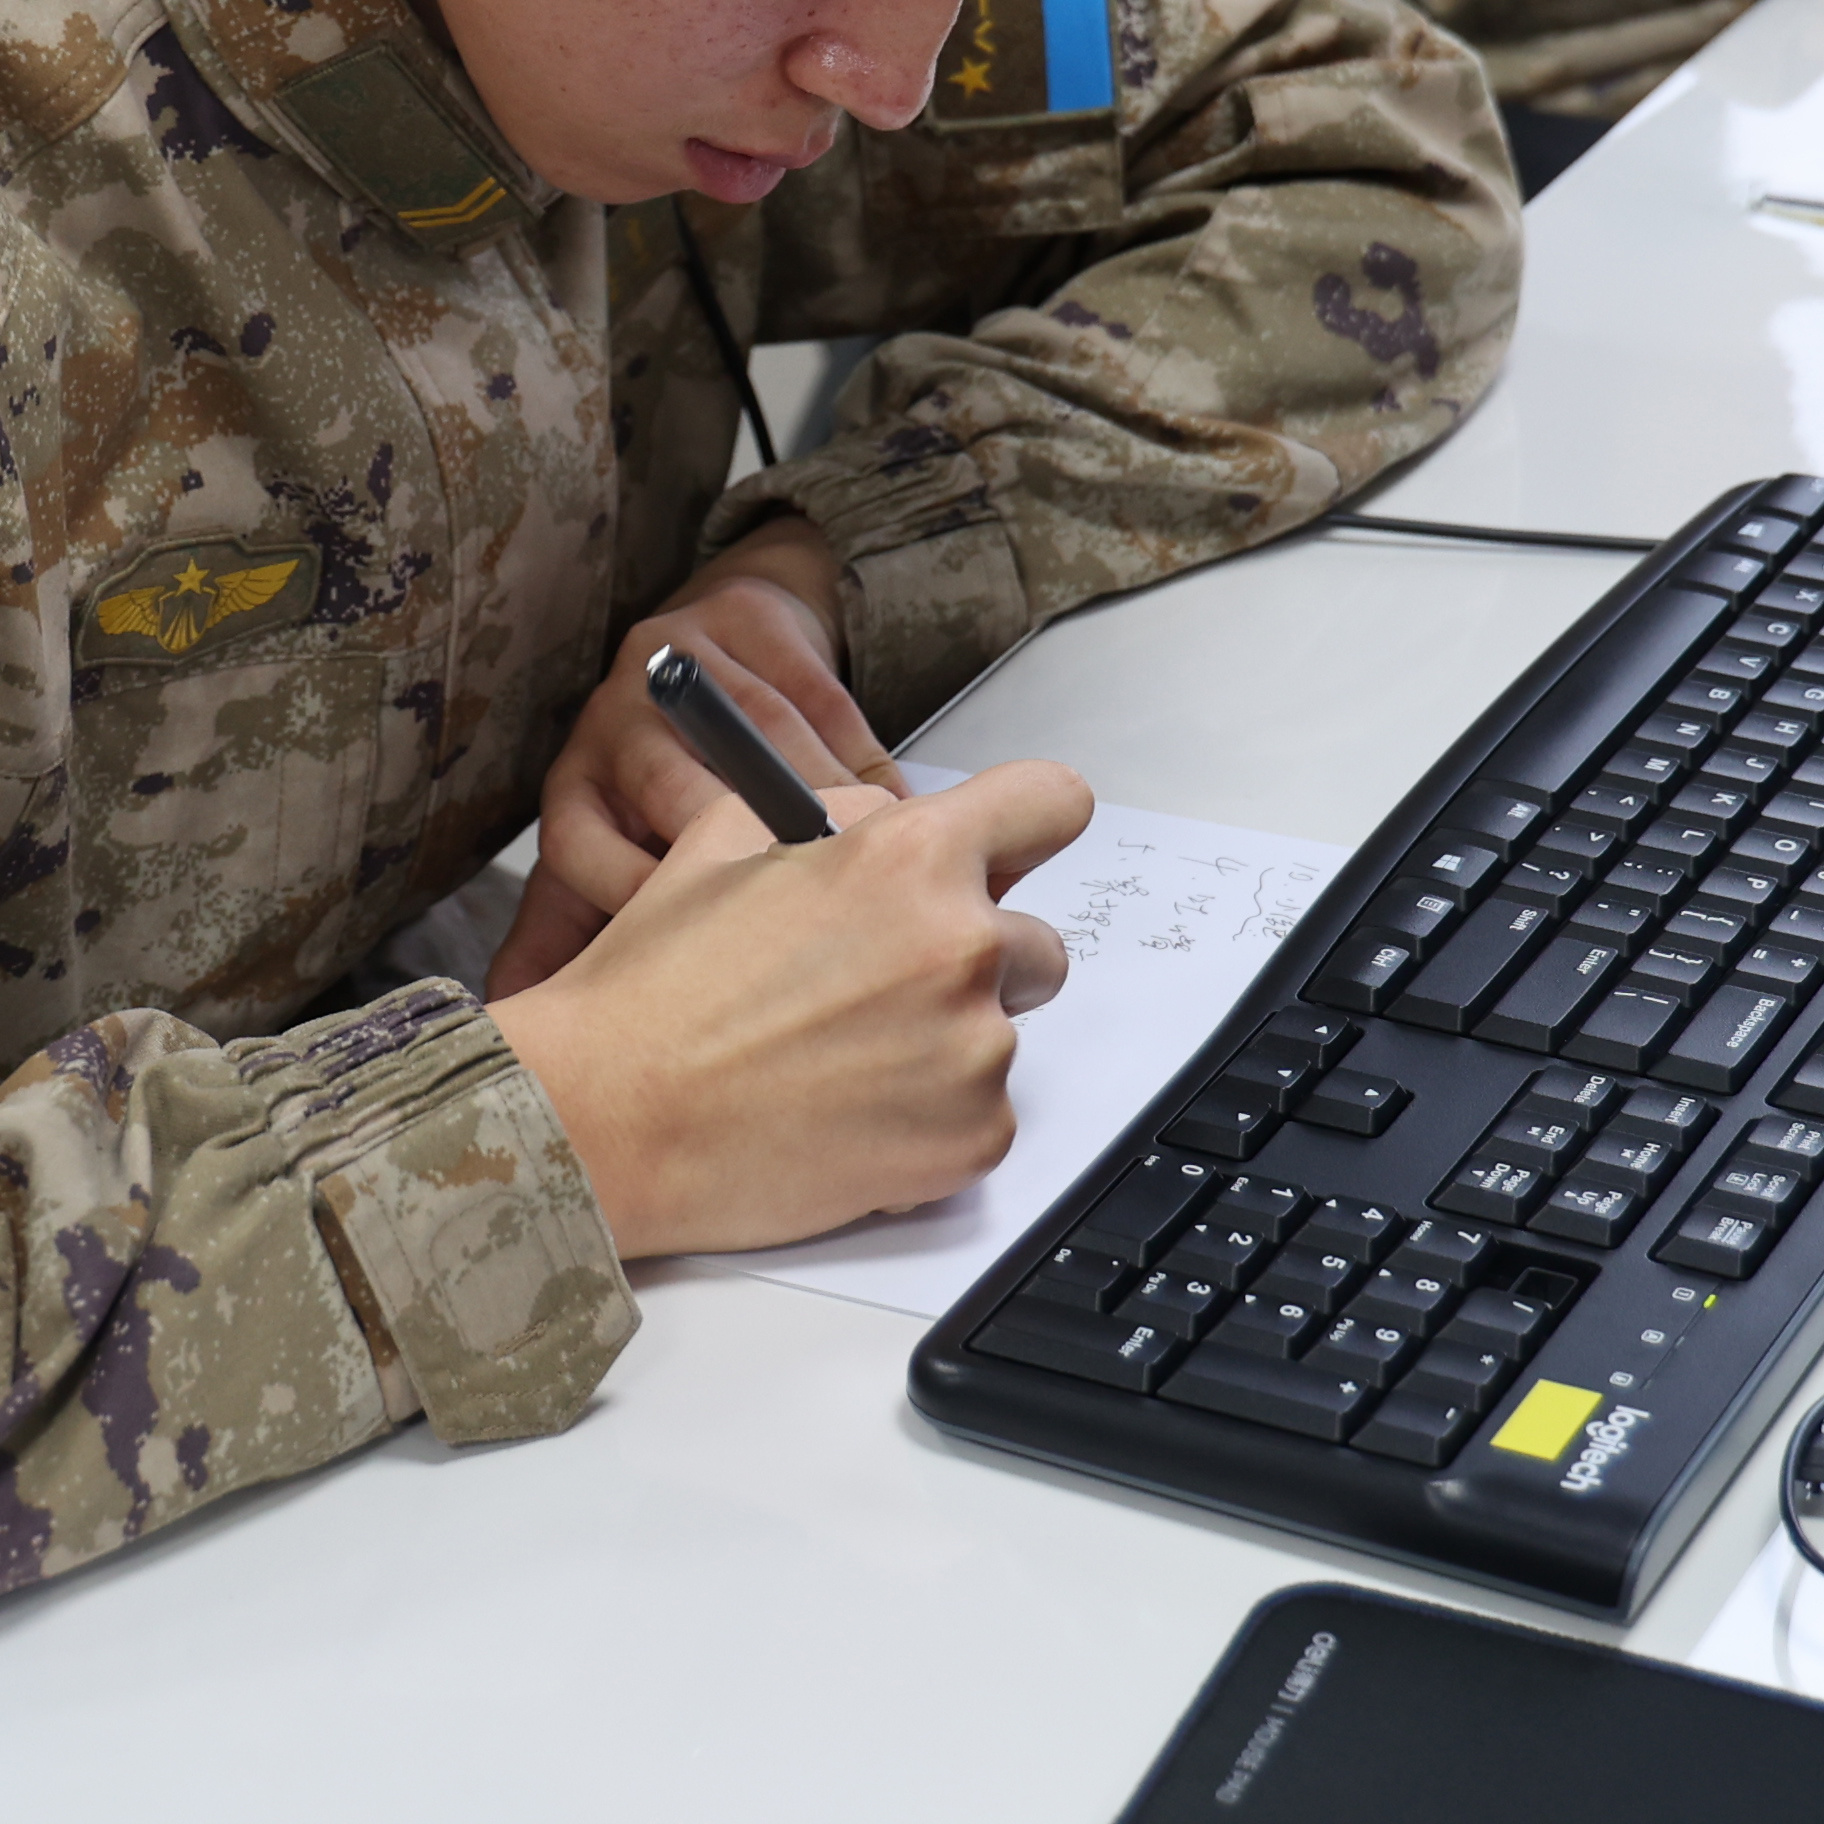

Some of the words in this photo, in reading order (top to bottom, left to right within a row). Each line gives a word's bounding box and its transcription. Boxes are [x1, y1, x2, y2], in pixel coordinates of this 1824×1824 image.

[1795, 588, 1818, 602] X
[1766, 622, 1790, 635] C
[1739, 656, 1761, 669] V
[1708, 688, 1731, 700] B
[1676, 722, 1701, 736] N
[1774, 721, 1799, 735] H
[1644, 757, 1670, 772] M
[1745, 758, 1766, 769] J
[1711, 792, 1737, 805] K
[1507, 803, 1531, 819] Alt
[1681, 829, 1706, 840] L
[1774, 839, 1797, 851] O
[1747, 877, 1769, 890] P
[1509, 909, 1538, 931] Shift
[1371, 948, 1396, 968] Ctrl
[1576, 948, 1607, 974] Enter
[1726, 998, 1776, 1048] Backspace
[1573, 1075, 1606, 1104] Delete
[1664, 1097, 1697, 1123] Insert
[1541, 1125, 1566, 1145] End
[1630, 1142, 1661, 1170] Home
[1181, 1164, 1204, 1175] 0
[1480, 1163, 1512, 1189] Down
[1502, 1169, 1531, 1192] Page
[1743, 1172, 1769, 1192] Lock
[1271, 1187, 1294, 1198] 1
[1577, 1191, 1599, 1206] Up
[1594, 1190, 1623, 1214] Page
[1362, 1208, 1384, 1221] 4
[1228, 1233, 1252, 1246] 2
[1458, 1231, 1481, 1244] 7
[1322, 1255, 1346, 1269] 5
[1187, 1281, 1211, 1295] 3
[1415, 1279, 1440, 1292] 8
[1279, 1304, 1304, 1319] 6
[1118, 1326, 1154, 1357] Enter
[1376, 1328, 1400, 1342] 9
[1560, 1405, 1650, 1492] logitech
